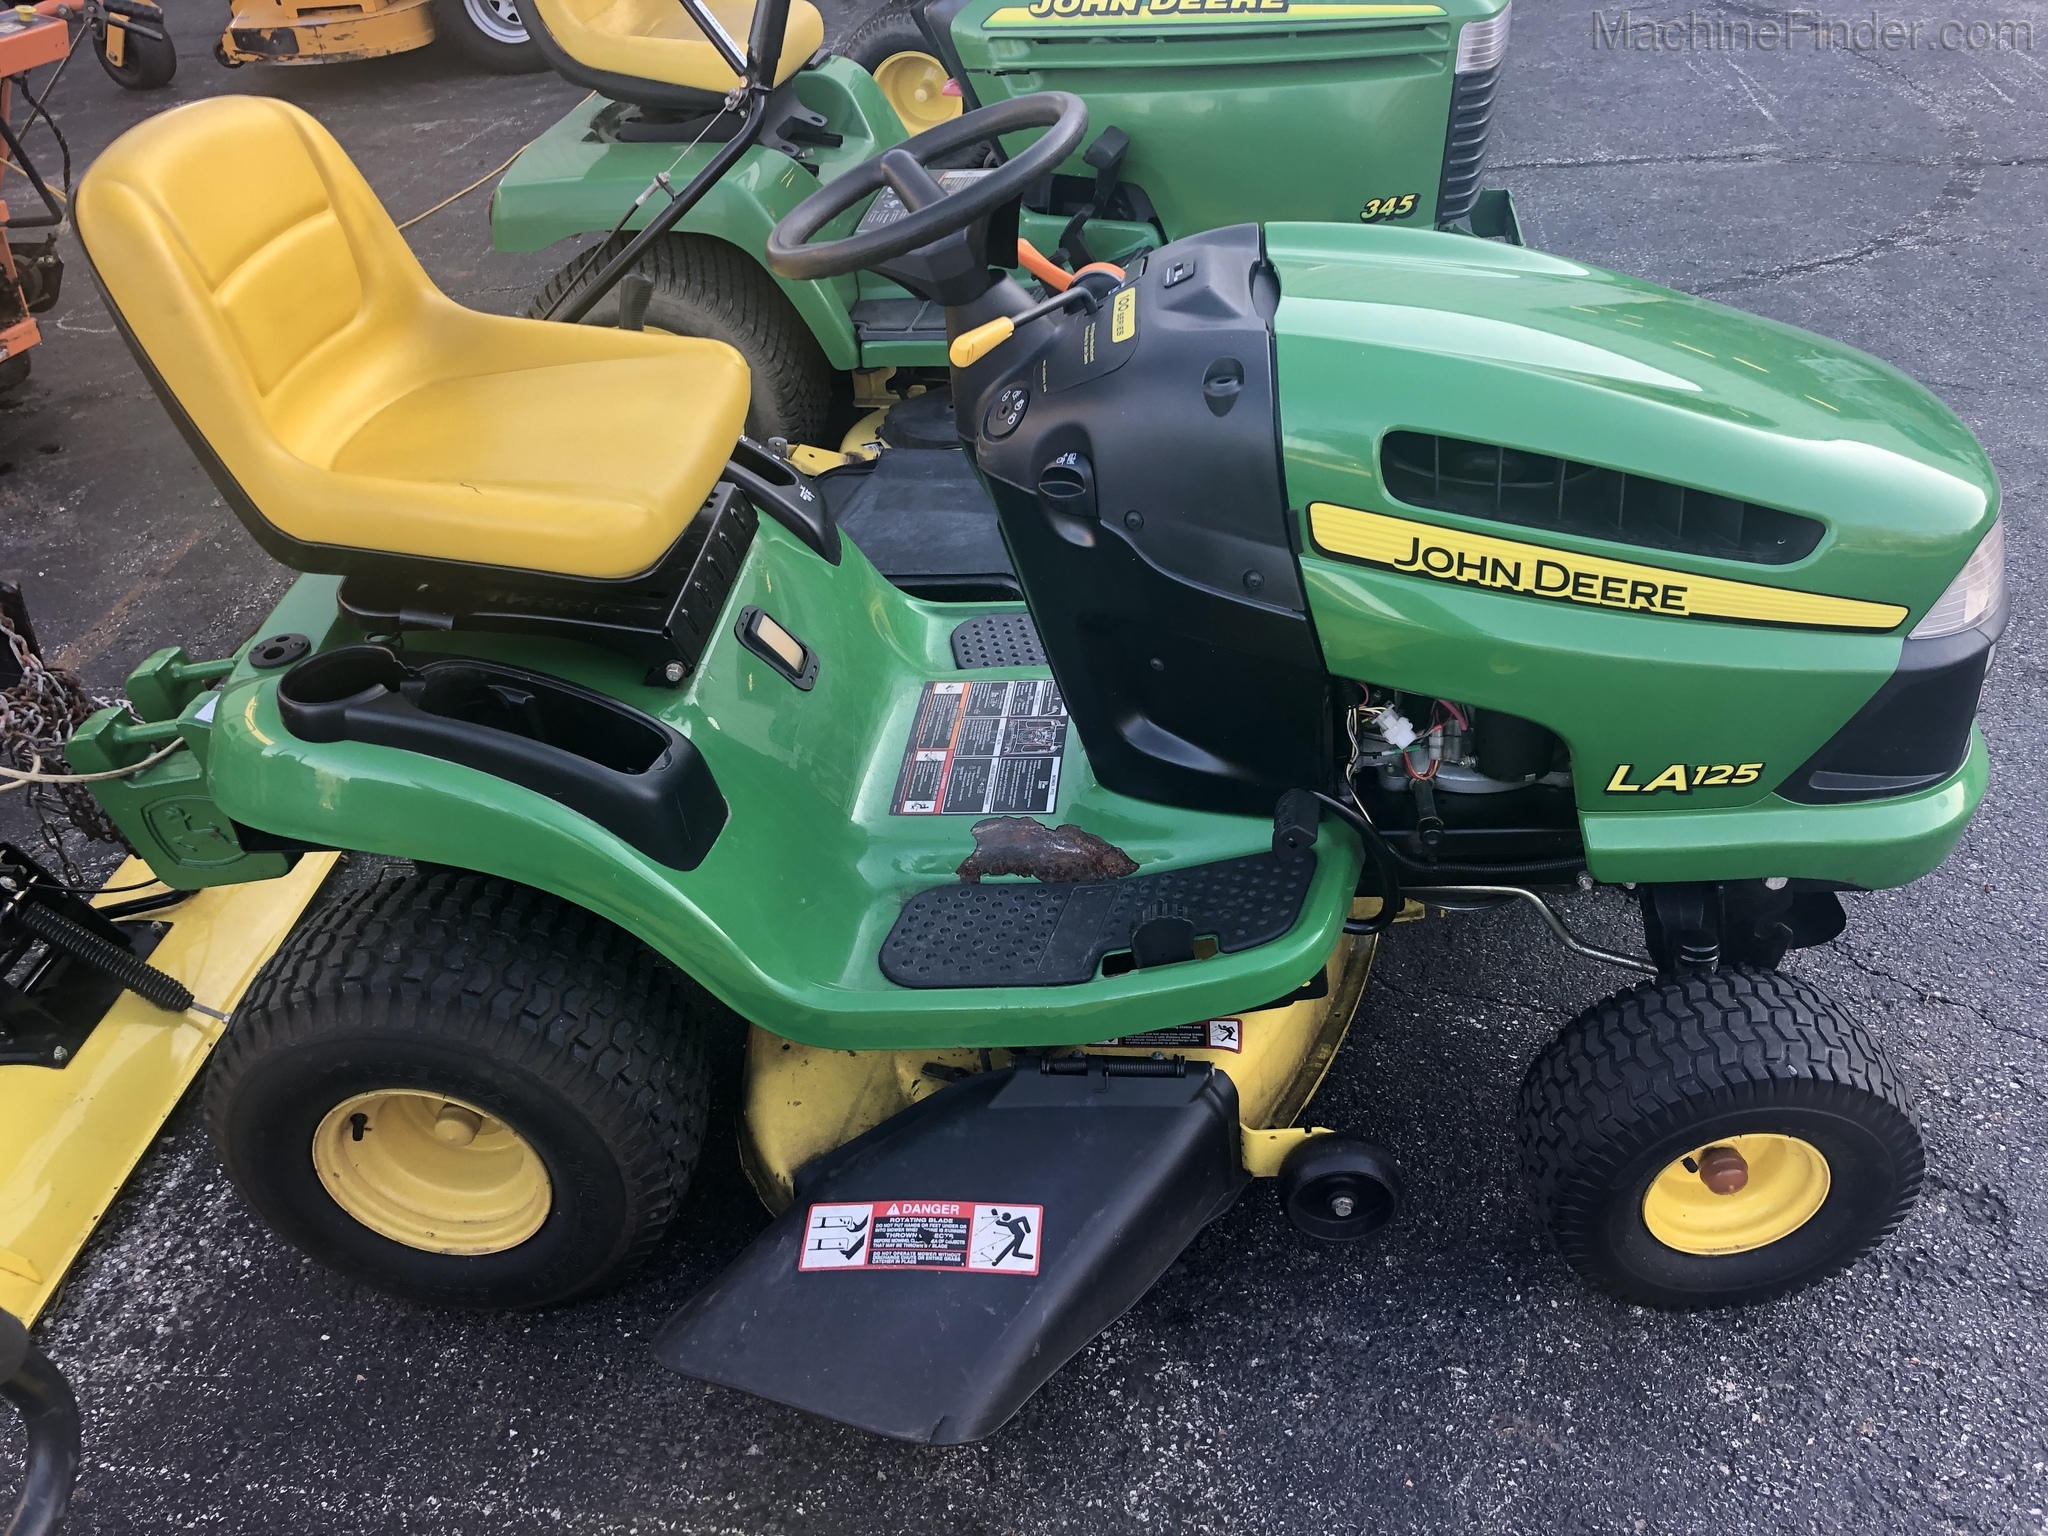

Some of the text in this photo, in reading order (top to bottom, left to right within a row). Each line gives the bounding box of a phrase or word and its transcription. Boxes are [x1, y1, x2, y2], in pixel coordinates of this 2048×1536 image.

[1360, 194, 1419, 222] 345
[1118, 294, 1129, 311] 100
[1394, 537, 1689, 612] JOHN DEERE
[1605, 762, 1765, 793] LA125
[902, 1203, 960, 1215] DANGER
